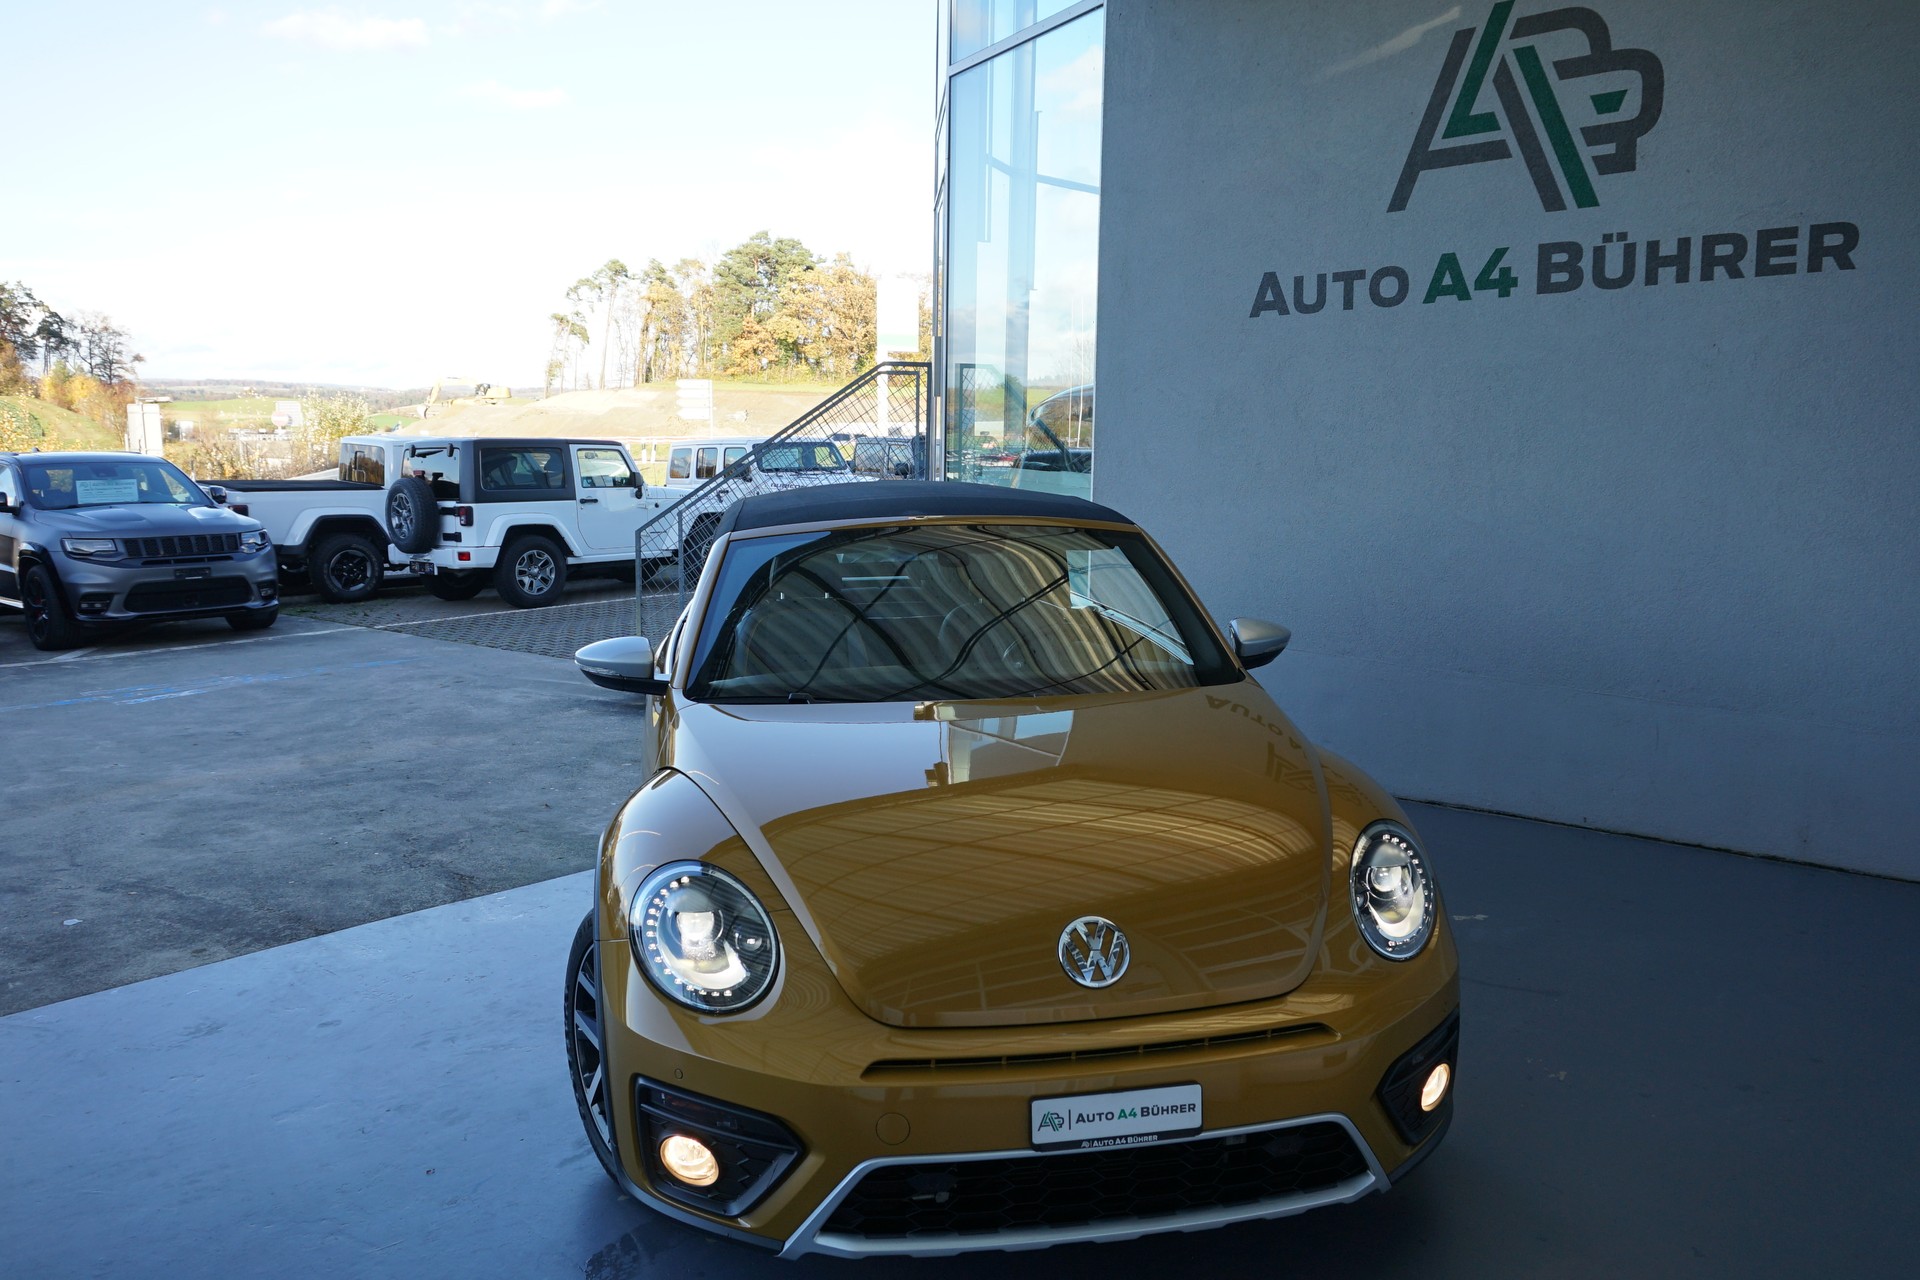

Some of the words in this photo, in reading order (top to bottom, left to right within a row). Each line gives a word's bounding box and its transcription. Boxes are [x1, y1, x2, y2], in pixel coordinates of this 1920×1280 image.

[1249, 265, 1410, 319] AUTO
[1422, 246, 1519, 304] A4
[1536, 220, 1860, 296] BÜHRER
[1075, 1111, 1115, 1124] AUTO
[1117, 1107, 1138, 1120] A4
[1140, 1103, 1197, 1118] BÜHRER
[1092, 1139, 1114, 1147] AUTO
[1115, 1137, 1127, 1145] A4
[1127, 1134, 1158, 1144] BÜHRER
